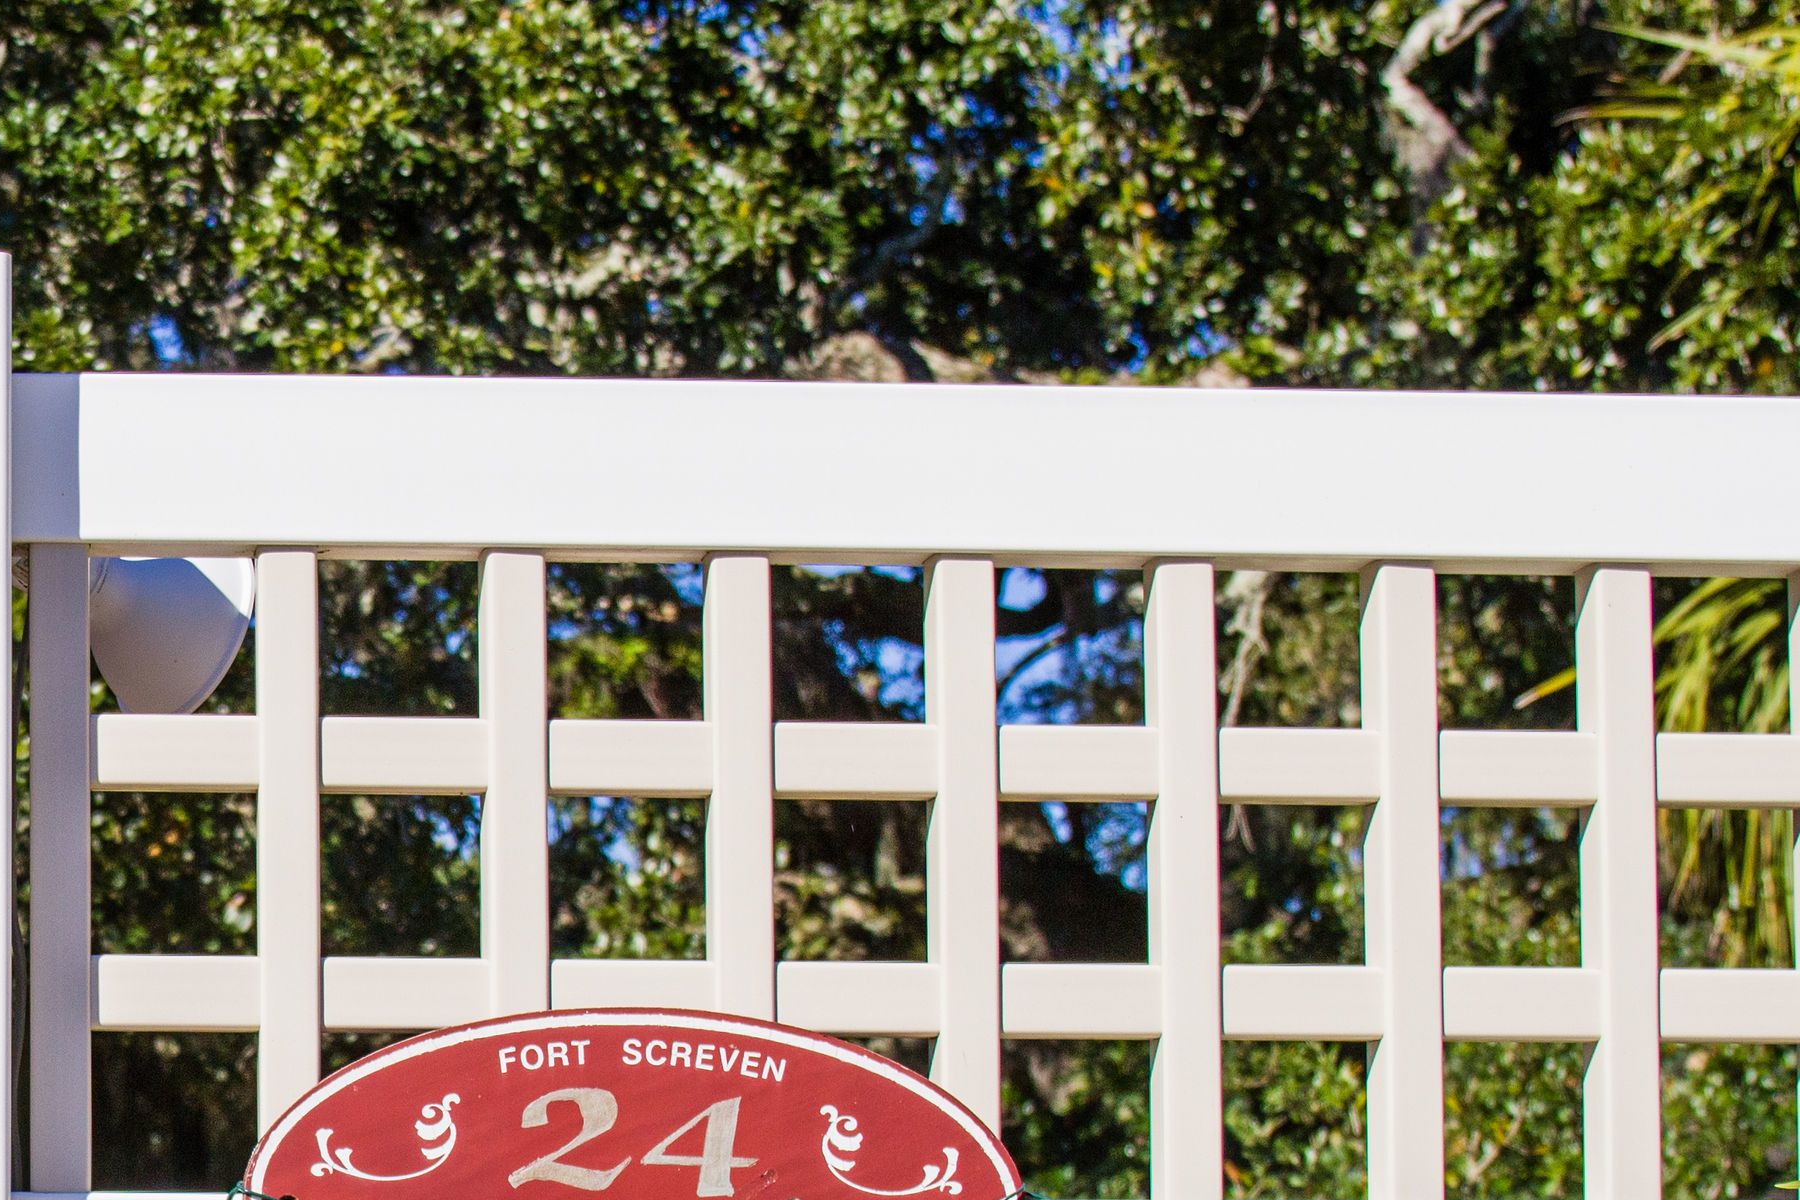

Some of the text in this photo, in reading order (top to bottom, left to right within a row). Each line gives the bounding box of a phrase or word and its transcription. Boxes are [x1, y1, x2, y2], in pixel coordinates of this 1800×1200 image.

[499, 1039, 787, 1083] FORT SCREVEN
[508, 1086, 759, 1198] 24
